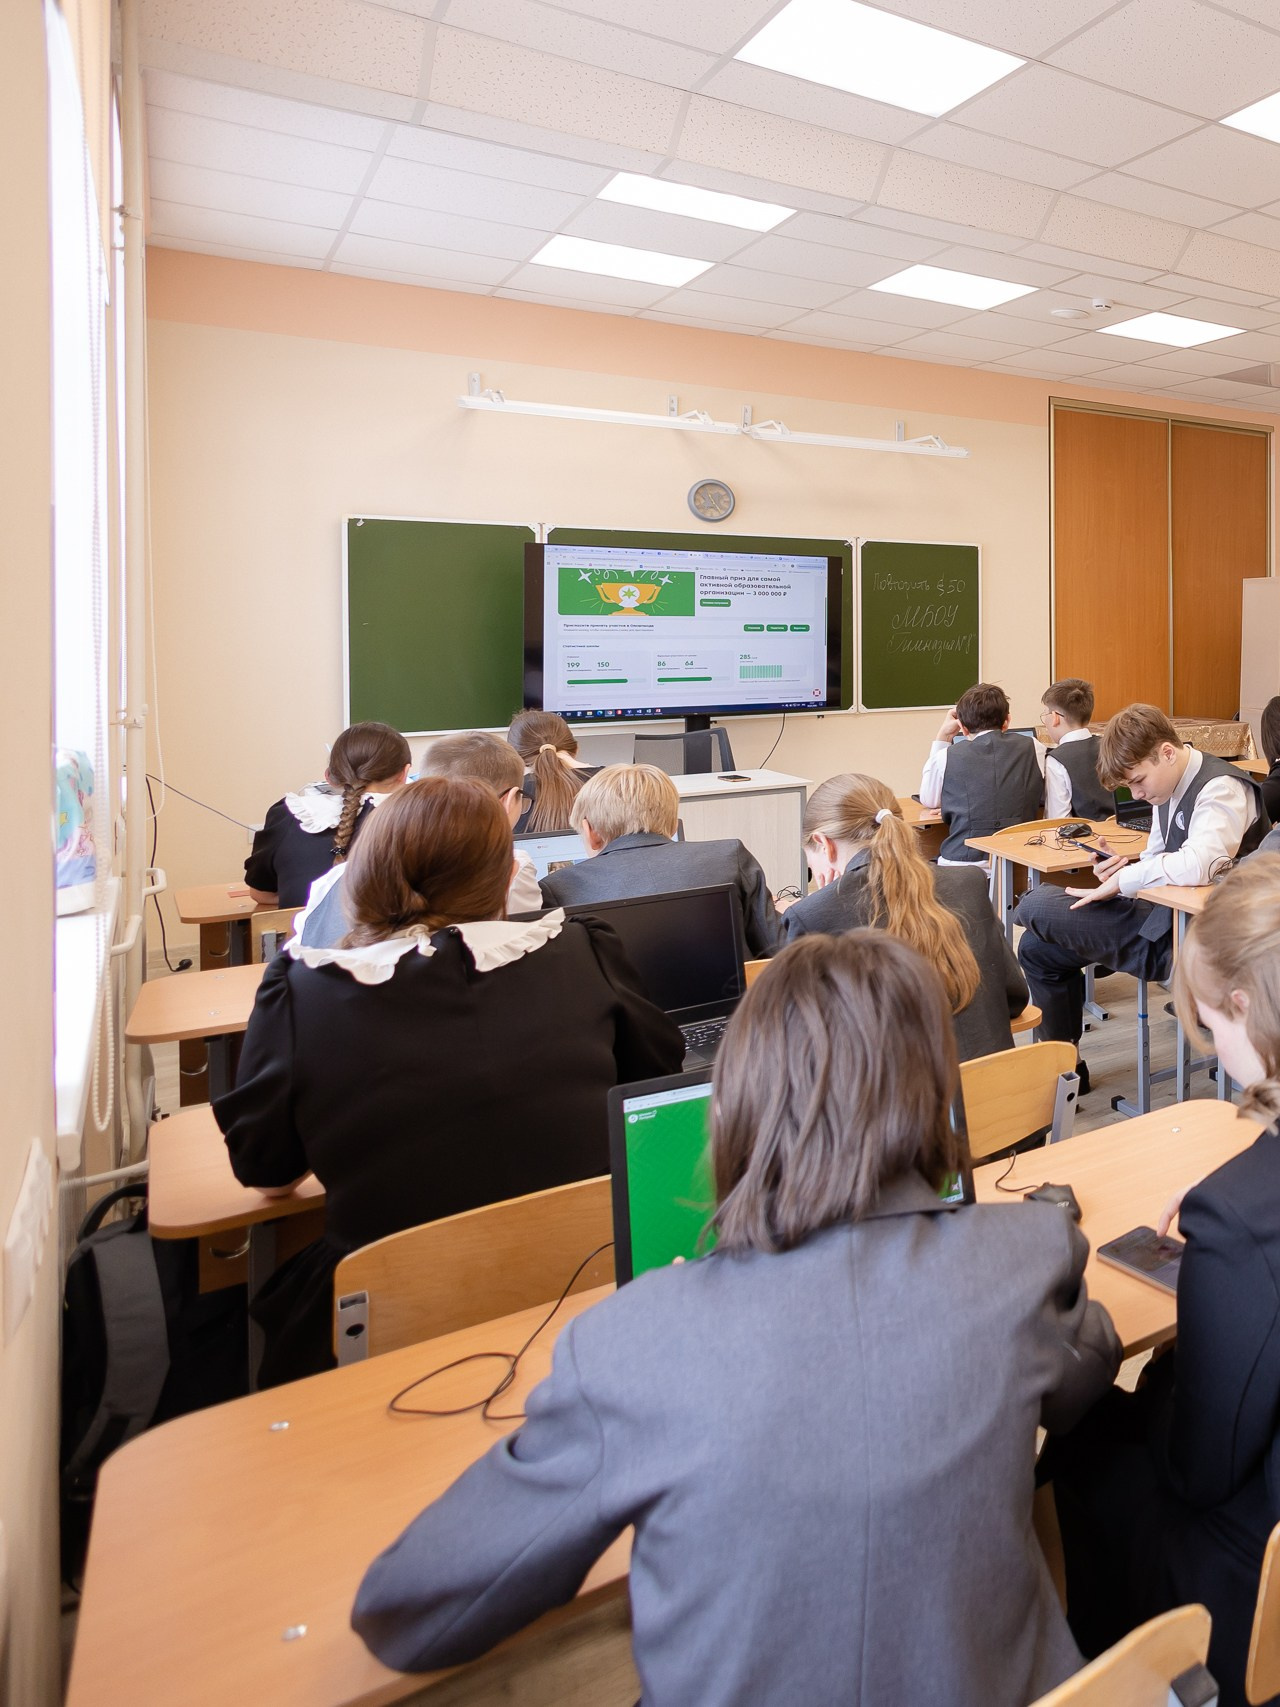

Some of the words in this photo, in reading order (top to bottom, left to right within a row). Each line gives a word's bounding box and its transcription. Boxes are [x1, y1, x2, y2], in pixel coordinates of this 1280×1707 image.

[873, 573, 930, 600] Повторить
[891, 604, 959, 630] МБОУ
[567, 661, 581, 669] 199
